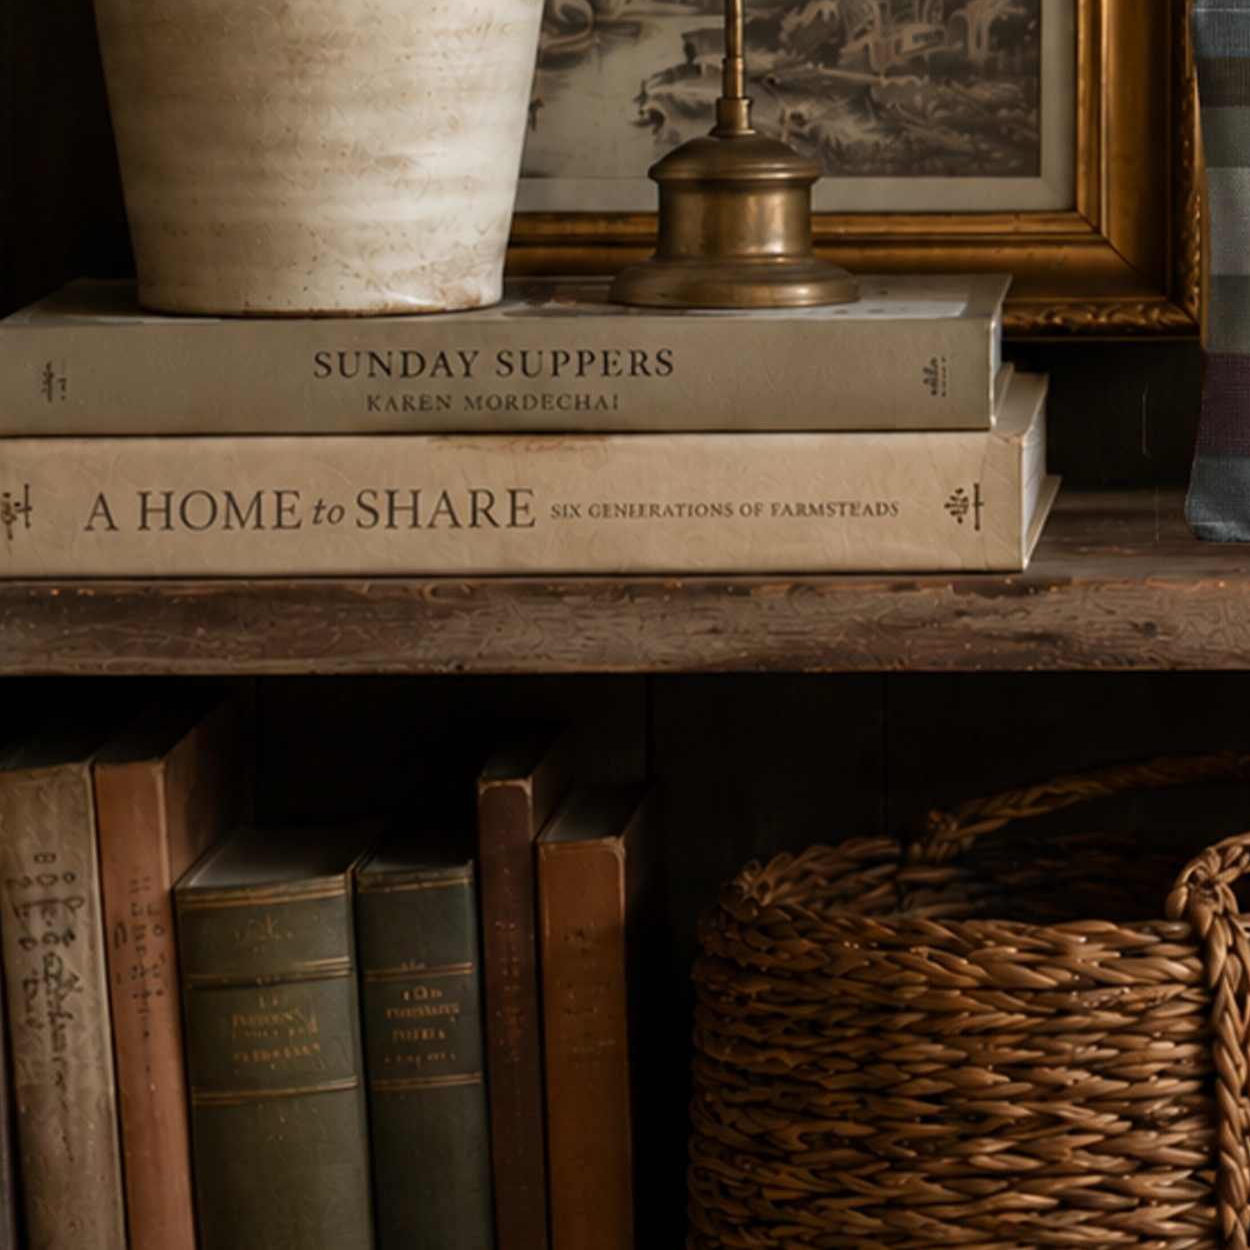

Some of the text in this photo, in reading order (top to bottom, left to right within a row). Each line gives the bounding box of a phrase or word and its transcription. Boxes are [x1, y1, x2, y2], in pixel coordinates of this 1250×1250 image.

[313, 349, 675, 379] SUNDAY SUPPERS
[366, 393, 619, 413] KAREN MORDECHAI
[84, 492, 118, 532] A
[137, 490, 301, 531] HOME
[312, 497, 345, 525] to
[355, 488, 536, 529] SHARE
[550, 503, 582, 519] SIX
[739, 502, 763, 518] OF
[771, 500, 899, 518] FARMSTEADS
